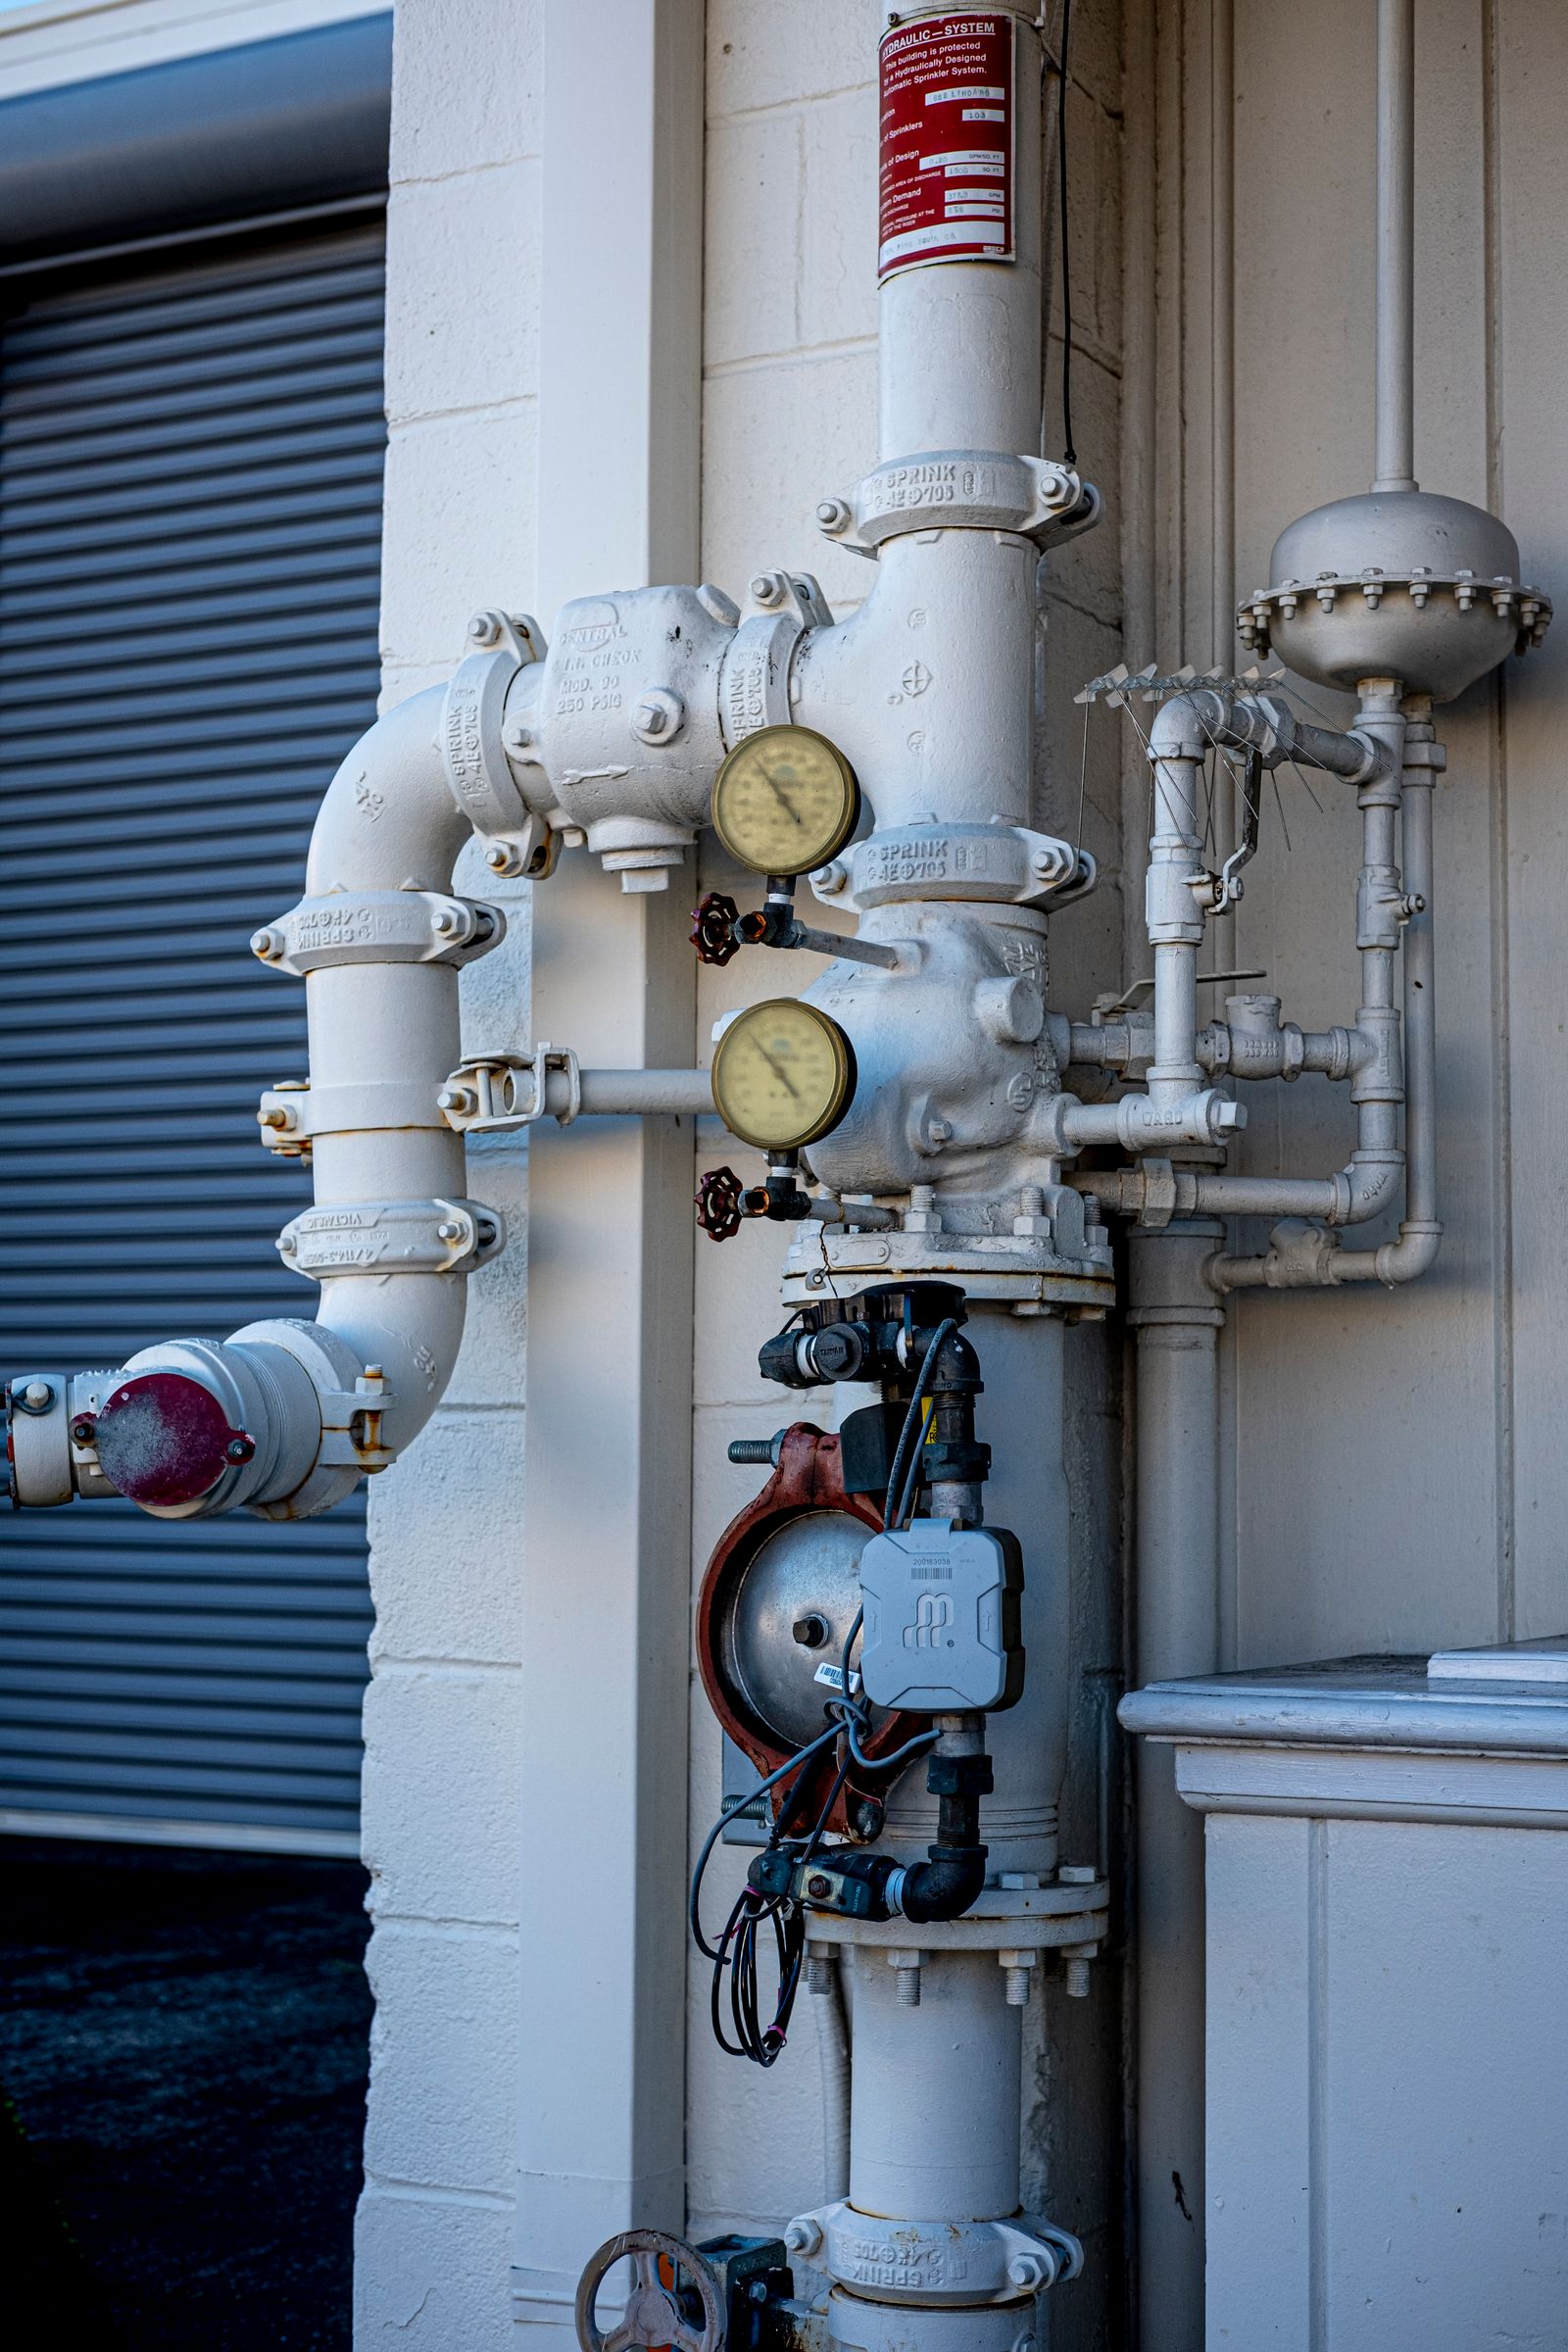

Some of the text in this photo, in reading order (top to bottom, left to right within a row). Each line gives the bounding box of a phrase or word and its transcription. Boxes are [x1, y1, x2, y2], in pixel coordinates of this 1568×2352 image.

[885, 59, 897, 72] This
[898, 50, 928, 67] building
[939, 41, 981, 55] protected
[894, 59, 943, 78] Hydraulically
[945, 53, 987, 66] Designed
[913, 70, 949, 84] Sprinkler
[951, 67, 988, 75] System.
[890, 121, 923, 139] Sprinklers
[888, 149, 919, 167] of Design
[913, 171, 942, 182] DISCHARGE
[893, 188, 921, 202] Demand
[896, 214, 917, 223] PRESSURE
[902, 220, 916, 229] RISER
[886, 465, 956, 489] SPRINK
[557, 697, 585, 714] 250
[729, 667, 747, 743] SPRINK
[446, 705, 466, 777] SPRINK
[878, 840, 949, 861] SPRINK
[297, 928, 355, 950] SPRINK
[308, 1213, 363, 1229] VICTAULIC
[853, 2264, 924, 2288] SPRINK
